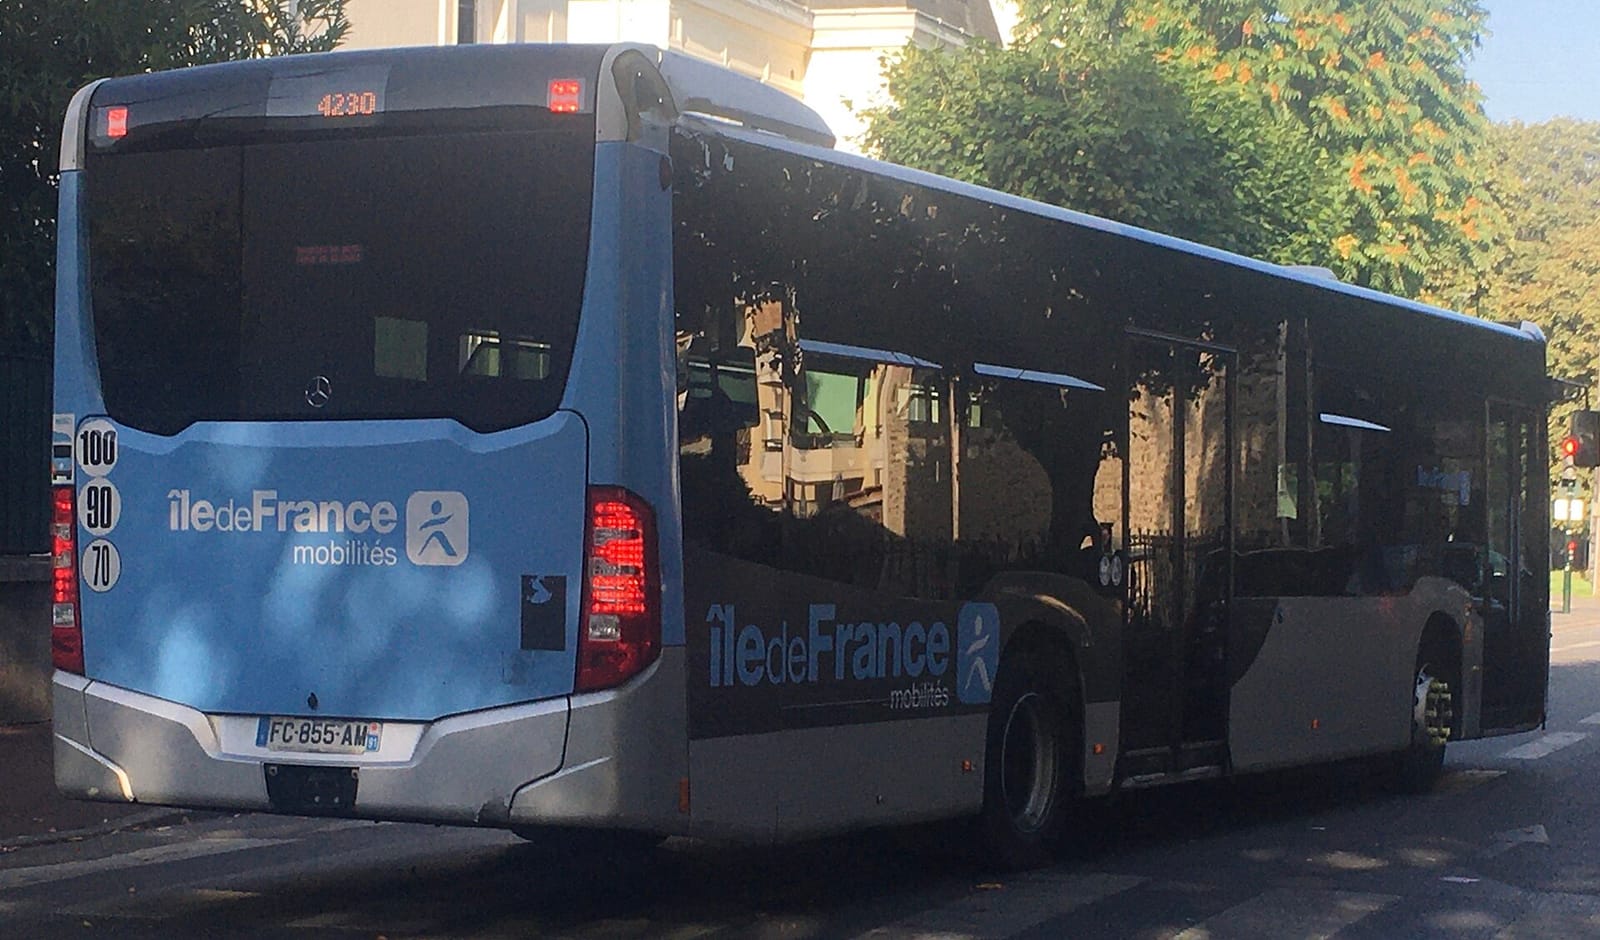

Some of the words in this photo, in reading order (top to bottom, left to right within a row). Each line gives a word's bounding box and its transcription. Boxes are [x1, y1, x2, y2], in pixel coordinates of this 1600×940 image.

[316, 91, 376, 117] 4230
[80, 431, 116, 466] 100
[86, 486, 112, 529] 90
[92, 545, 111, 587] 70
[293, 540, 398, 566] mobilités
[890, 680, 949, 709] mobilités
[269, 721, 368, 747] FC-855-AM
